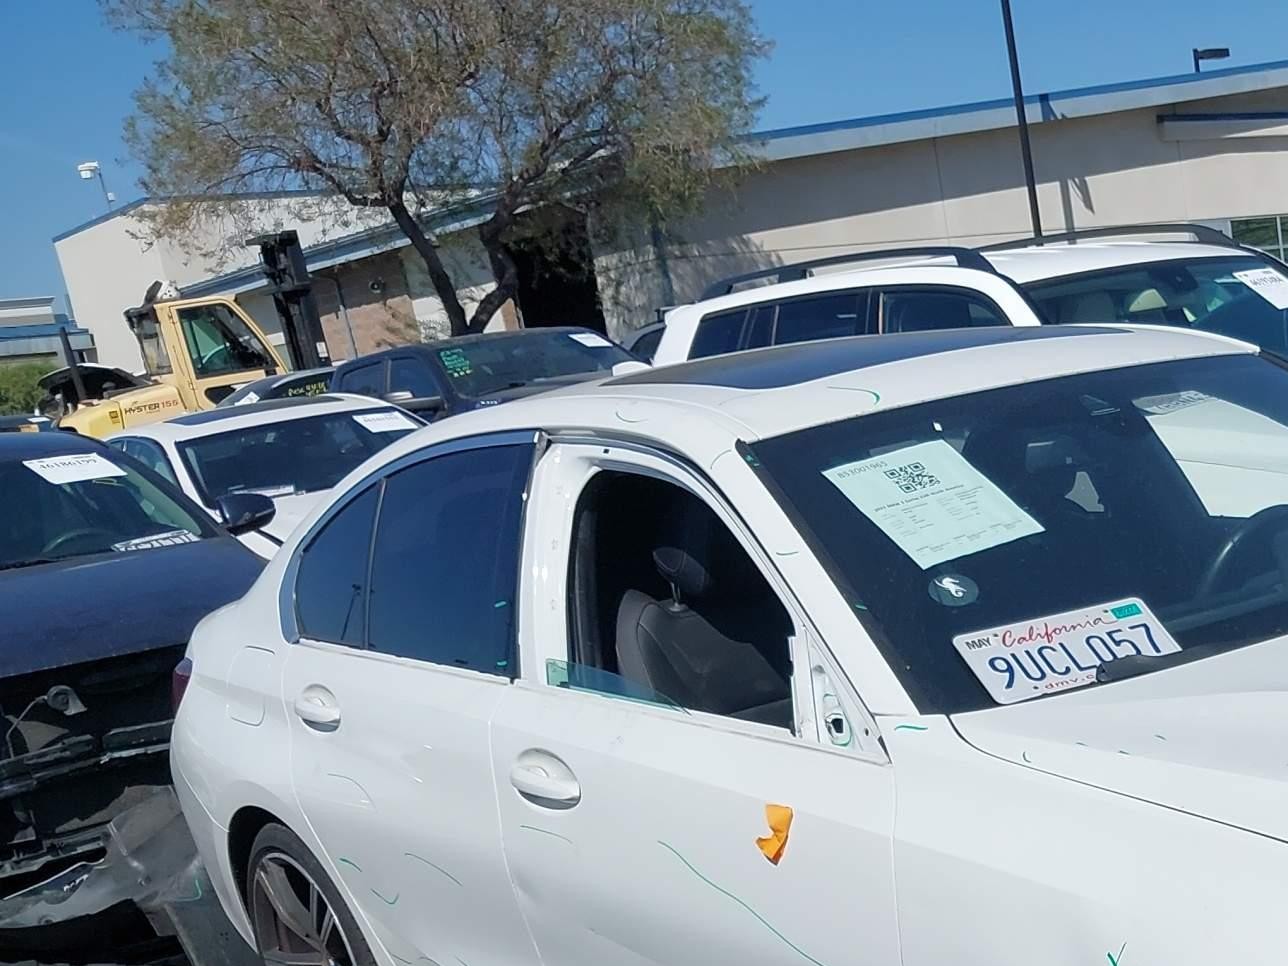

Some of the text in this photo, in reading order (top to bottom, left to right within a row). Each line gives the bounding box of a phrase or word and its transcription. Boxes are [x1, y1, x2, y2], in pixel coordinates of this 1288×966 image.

[124, 402, 160, 415] HYSTER
[965, 613, 1118, 650] MAY California
[987, 623, 1163, 690] 9UCL057
